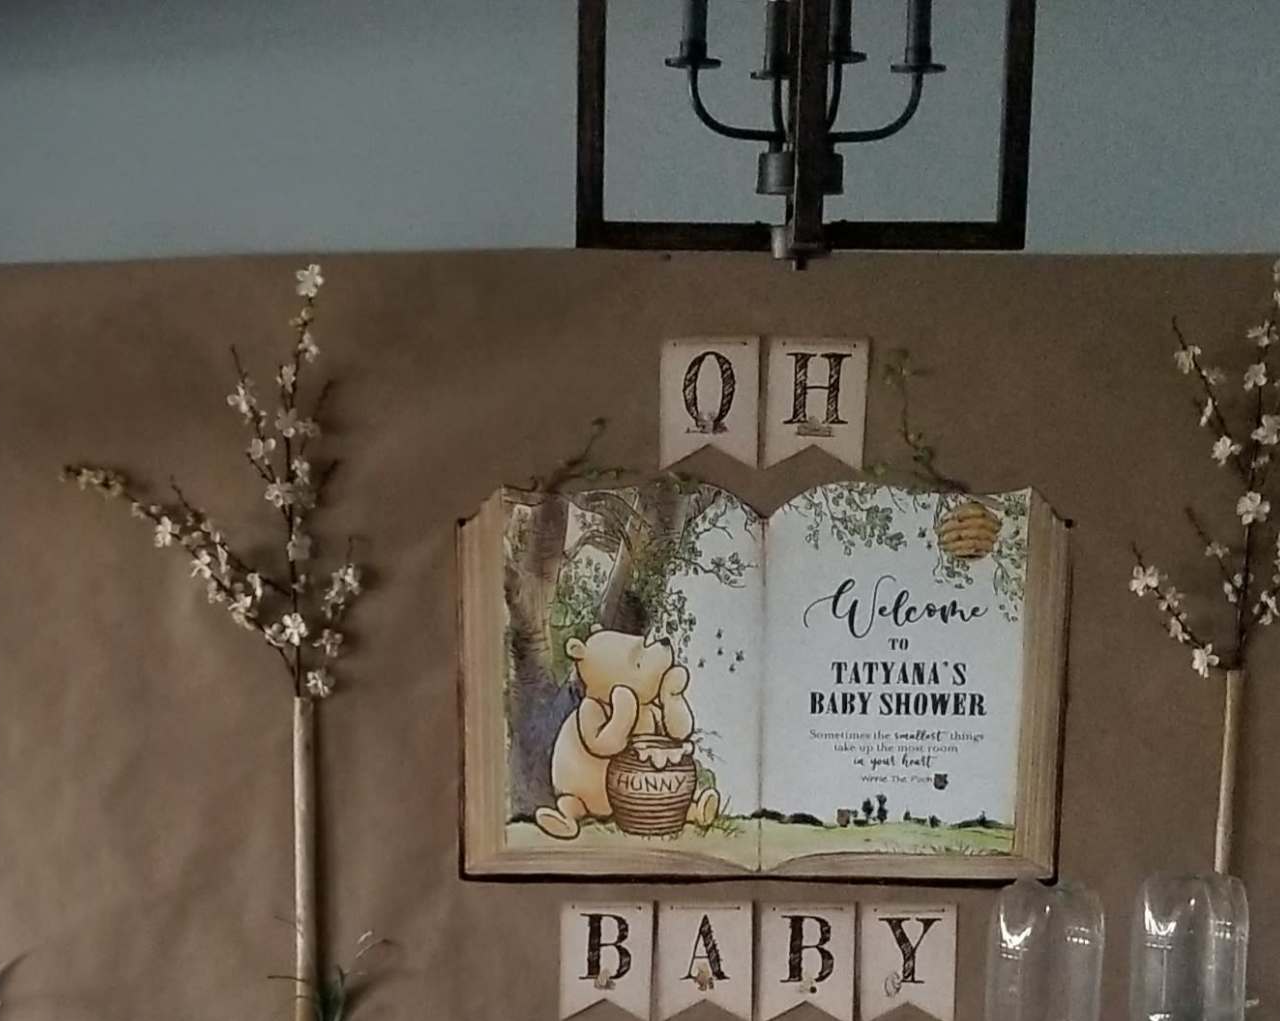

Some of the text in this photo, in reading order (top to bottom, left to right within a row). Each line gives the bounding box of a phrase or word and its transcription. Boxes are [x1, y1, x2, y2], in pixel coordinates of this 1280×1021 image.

[682, 350, 853, 426] OH
[803, 574, 989, 639] Welcome
[888, 637, 909, 651] TO
[831, 660, 967, 686] TATYANA'S
[810, 691, 987, 716] BABY SHOWER
[809, 729, 985, 743] Sometimes the smallest things
[833, 742, 856, 753] take
[876, 743, 894, 753] the
[616, 774, 687, 794] HUNNY
[578, 912, 943, 985] BABY
